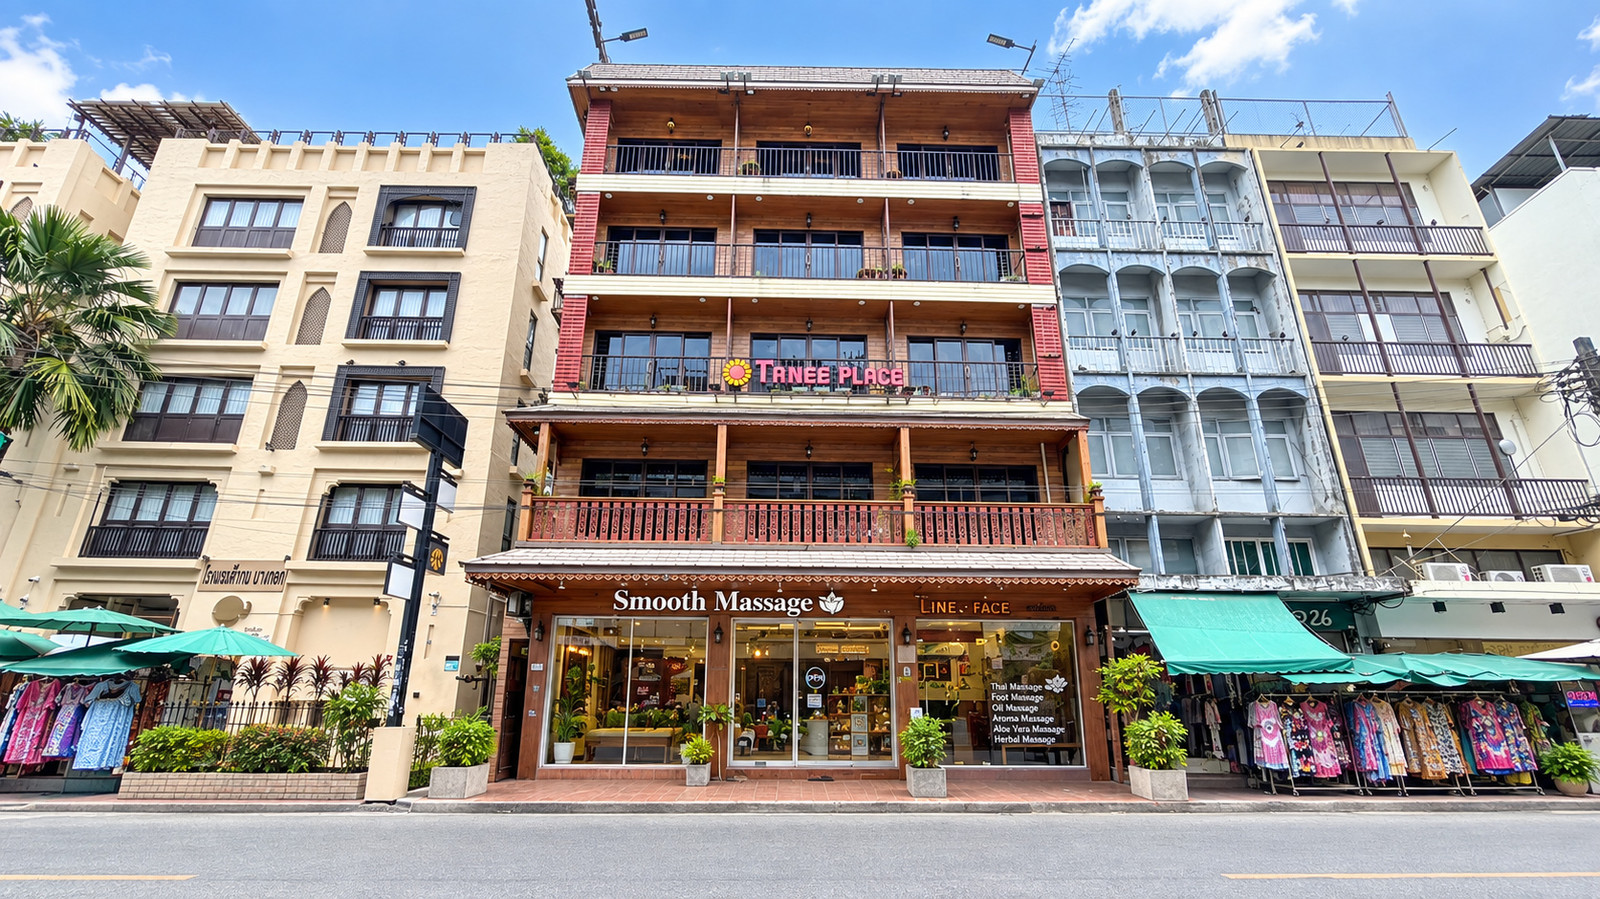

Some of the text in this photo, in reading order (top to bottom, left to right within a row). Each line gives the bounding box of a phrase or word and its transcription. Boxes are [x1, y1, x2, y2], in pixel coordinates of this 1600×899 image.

[755, 359, 905, 386] TANEE PLACE
[613, 589, 813, 617] Smooth Massage
[920, 599, 957, 614] LINE
[973, 601, 1011, 614] FACE
[1009, 683, 1043, 693] Massage
[991, 692, 1044, 703] Foot Massage
[991, 703, 1039, 714] Oil Massage
[992, 714, 1055, 725] Aroma Massage
[993, 724, 1011, 733] Aloe
[1032, 724, 1066, 735] Massage
[994, 735, 1056, 745] Herbal Massage
